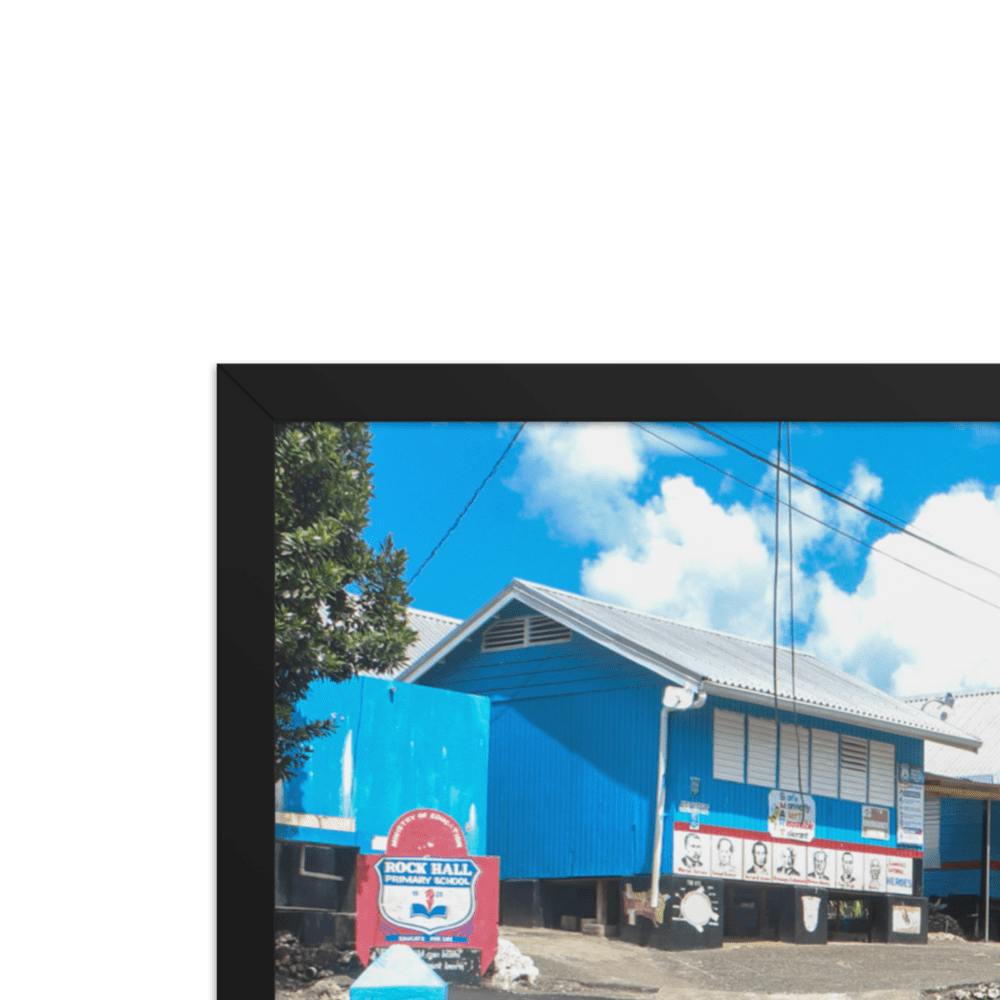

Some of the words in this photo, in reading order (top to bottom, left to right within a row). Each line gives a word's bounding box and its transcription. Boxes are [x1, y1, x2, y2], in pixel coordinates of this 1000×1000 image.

[391, 814, 415, 848] MINISTRY
[416, 811, 428, 819] OF
[384, 861, 428, 875] ROCK
[430, 862, 473, 876] HALL
[384, 875, 432, 885] PRIMARY
[433, 876, 471, 886] SCHOOL
